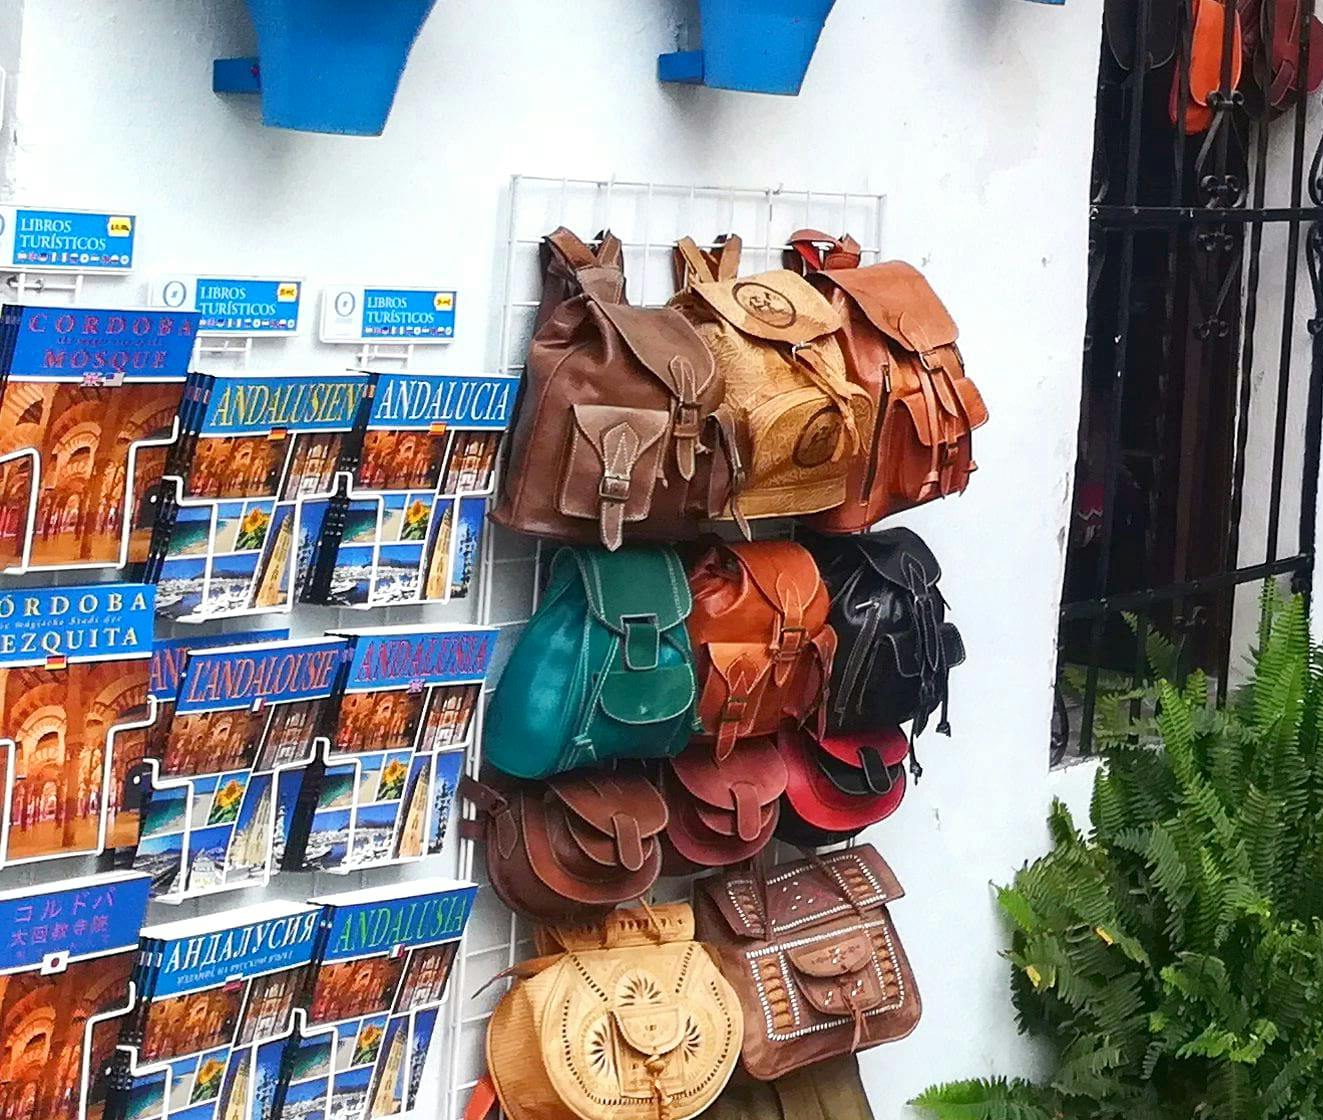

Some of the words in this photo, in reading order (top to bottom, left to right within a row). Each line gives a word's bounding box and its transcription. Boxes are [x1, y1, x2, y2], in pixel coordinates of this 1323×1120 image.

[20, 218, 72, 233] LIBROS
[19, 233, 106, 251] TURÍSTICOS
[200, 286, 247, 300] LIBROS
[367, 296, 407, 309] LIBROS
[199, 301, 277, 316] TURÍSTICOS
[366, 310, 435, 324] TURÍSTICOS
[43, 350, 168, 372] MOSQUE
[209, 382, 363, 427] ANDALUSIEN
[374, 379, 510, 421] ANDALUCIA
[186, 649, 340, 703] L'ANDALOUSIE
[332, 895, 468, 954] ANDALUSIA
[164, 912, 319, 975] АНДАЛУСИЯ
